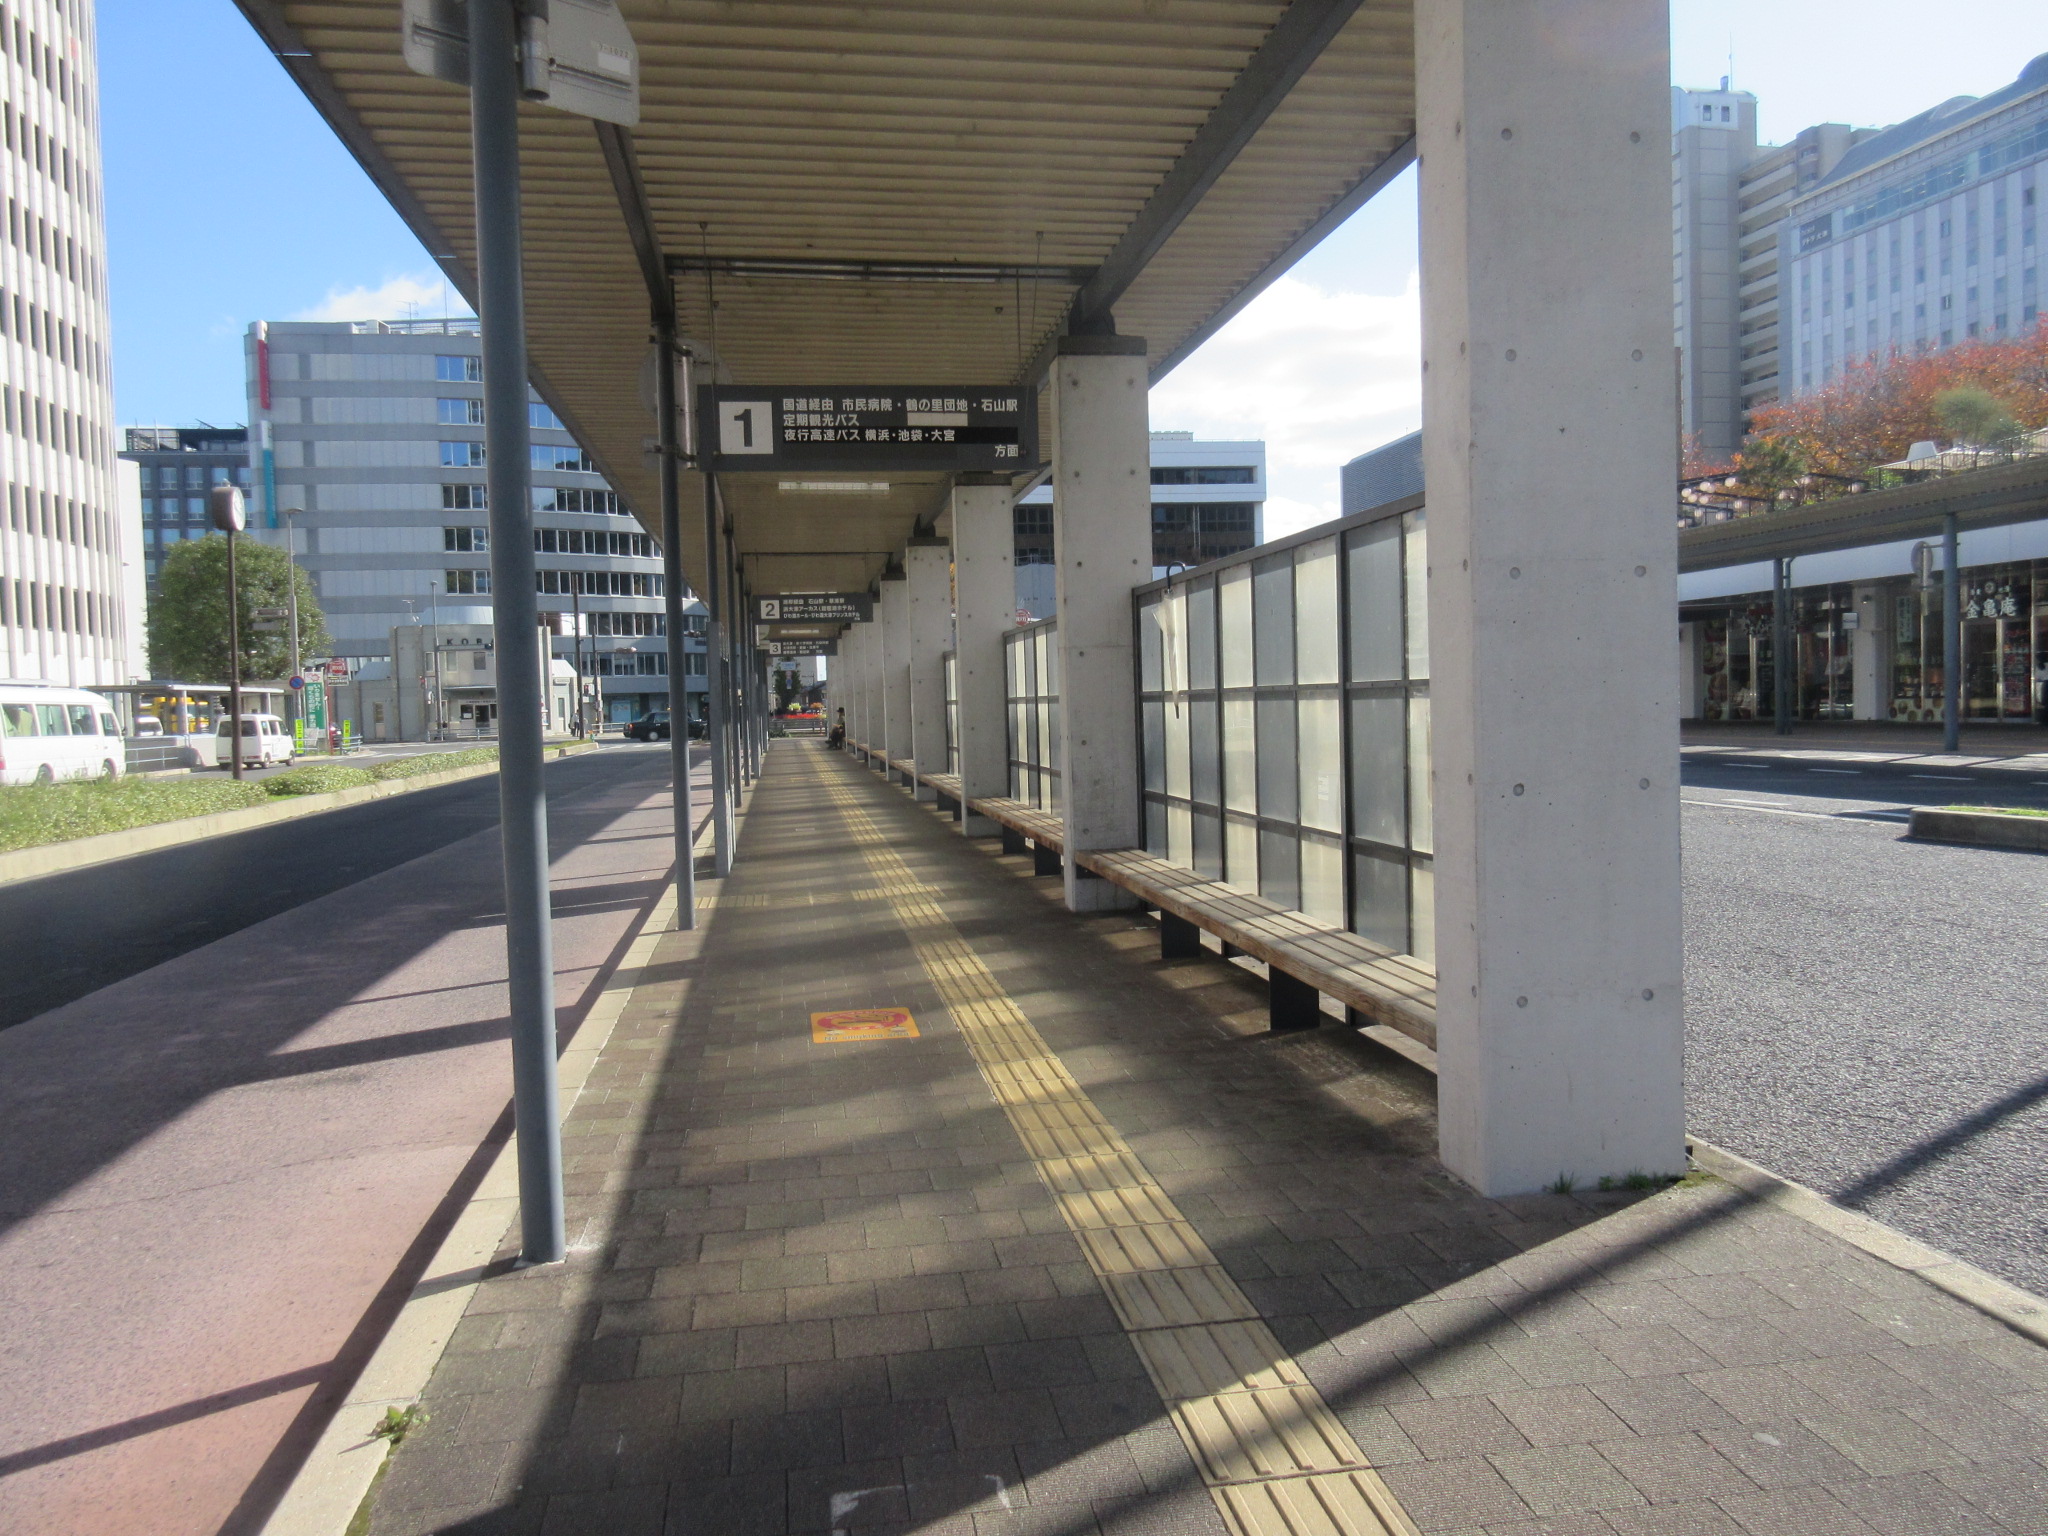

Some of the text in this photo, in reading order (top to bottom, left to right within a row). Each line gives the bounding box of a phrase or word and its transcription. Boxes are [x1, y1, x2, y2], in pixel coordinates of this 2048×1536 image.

[782, 398, 834, 412] 国道経由
[783, 413, 860, 427] 定期観光バス
[733, 408, 753, 448] 1
[784, 428, 956, 442] 夜行高速バス 横浜・池袋・大宮
[994, 444, 1019, 458] 方面
[765, 603, 775, 617] 2
[772, 644, 779, 653] 3
